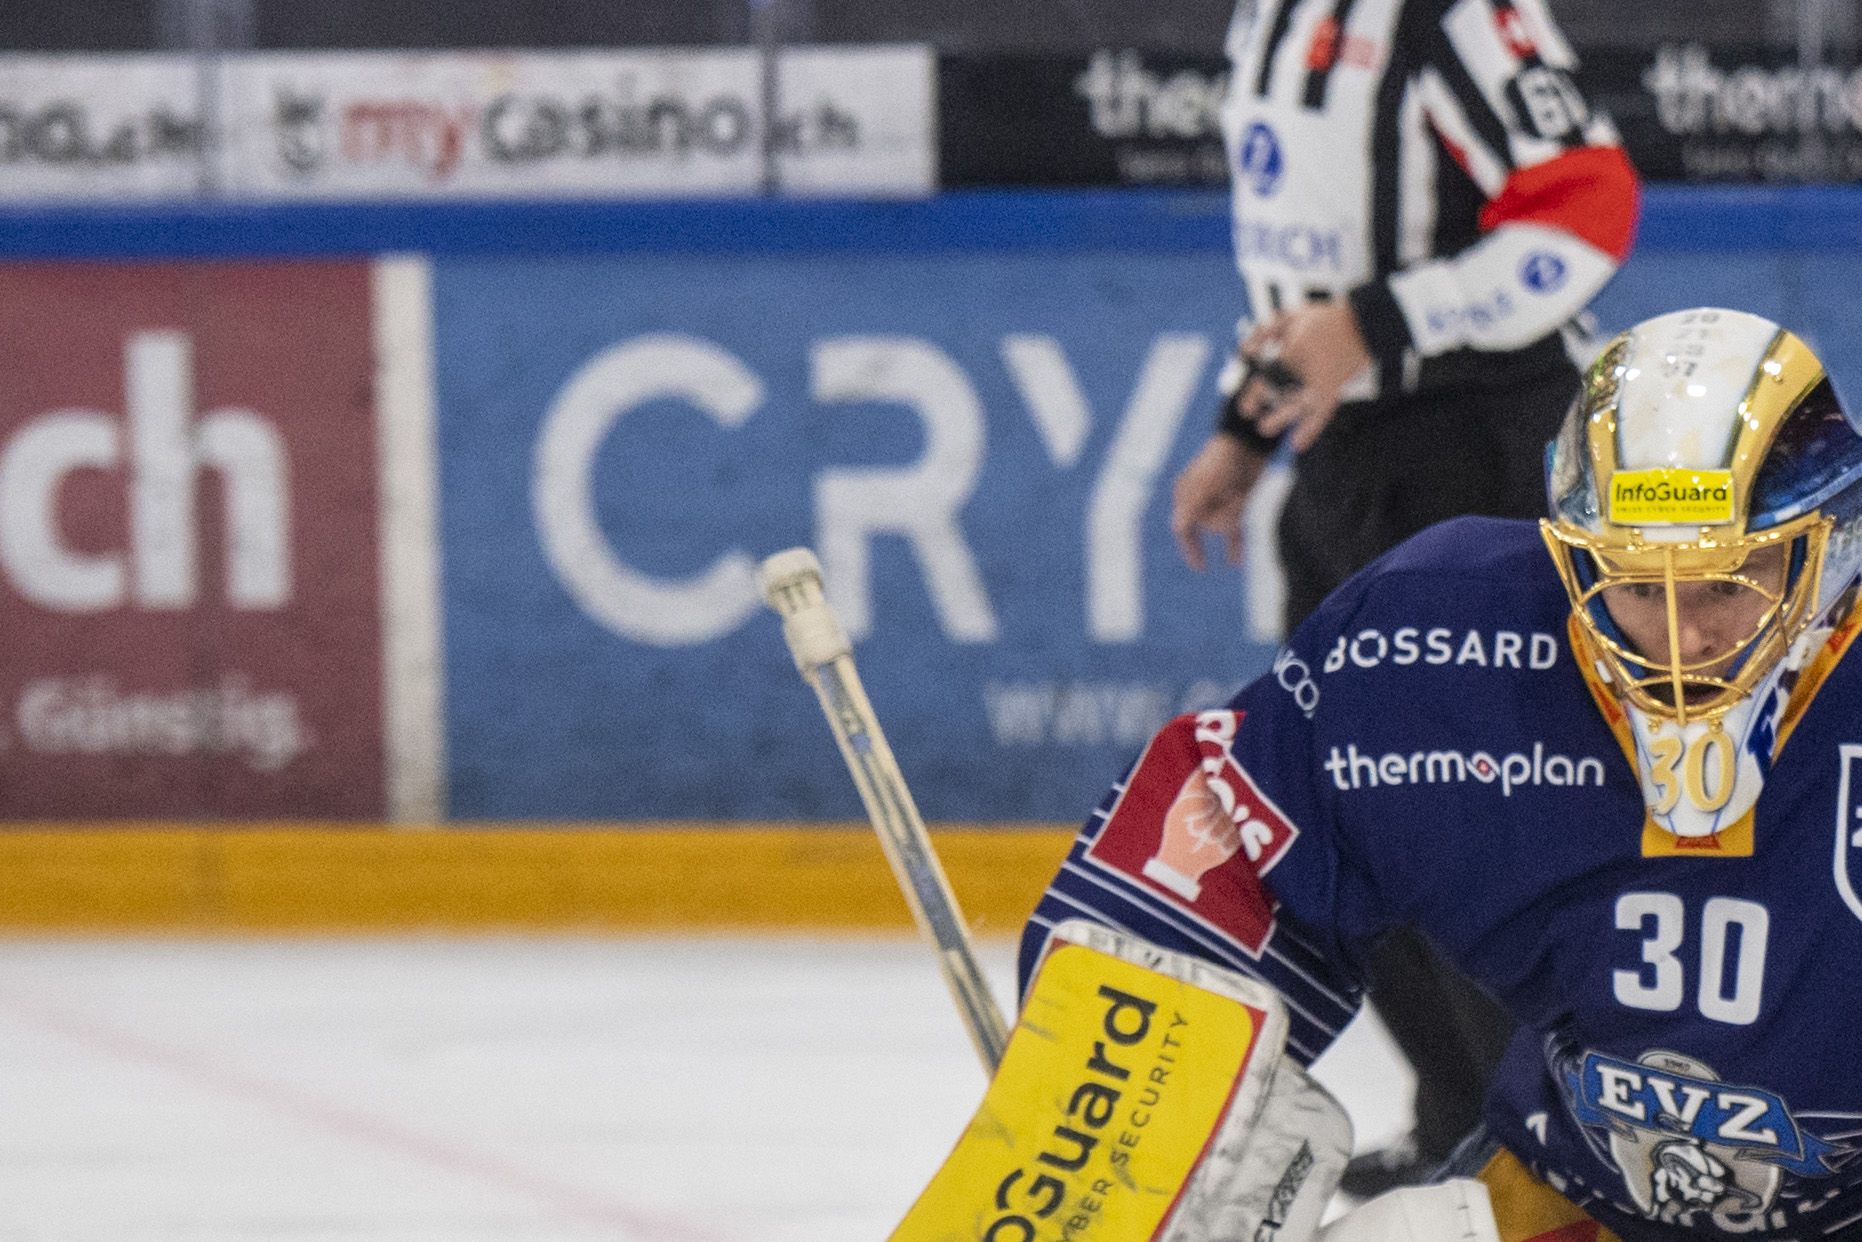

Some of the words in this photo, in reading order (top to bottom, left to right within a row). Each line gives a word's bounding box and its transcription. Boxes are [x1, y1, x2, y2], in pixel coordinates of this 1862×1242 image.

[343, 70, 861, 178] mycasinoch
[0, 328, 292, 612] ch
[1616, 483, 1727, 502] InfoGuard
[1323, 628, 1559, 673] BOSSARD
[1323, 742, 1605, 797] thermoplan
[1649, 733, 1738, 817] 30
[1611, 893, 1770, 1026] 30
[1111, 1010, 1191, 1166] SECURITY
[1595, 1064, 1779, 1146] EVZ
